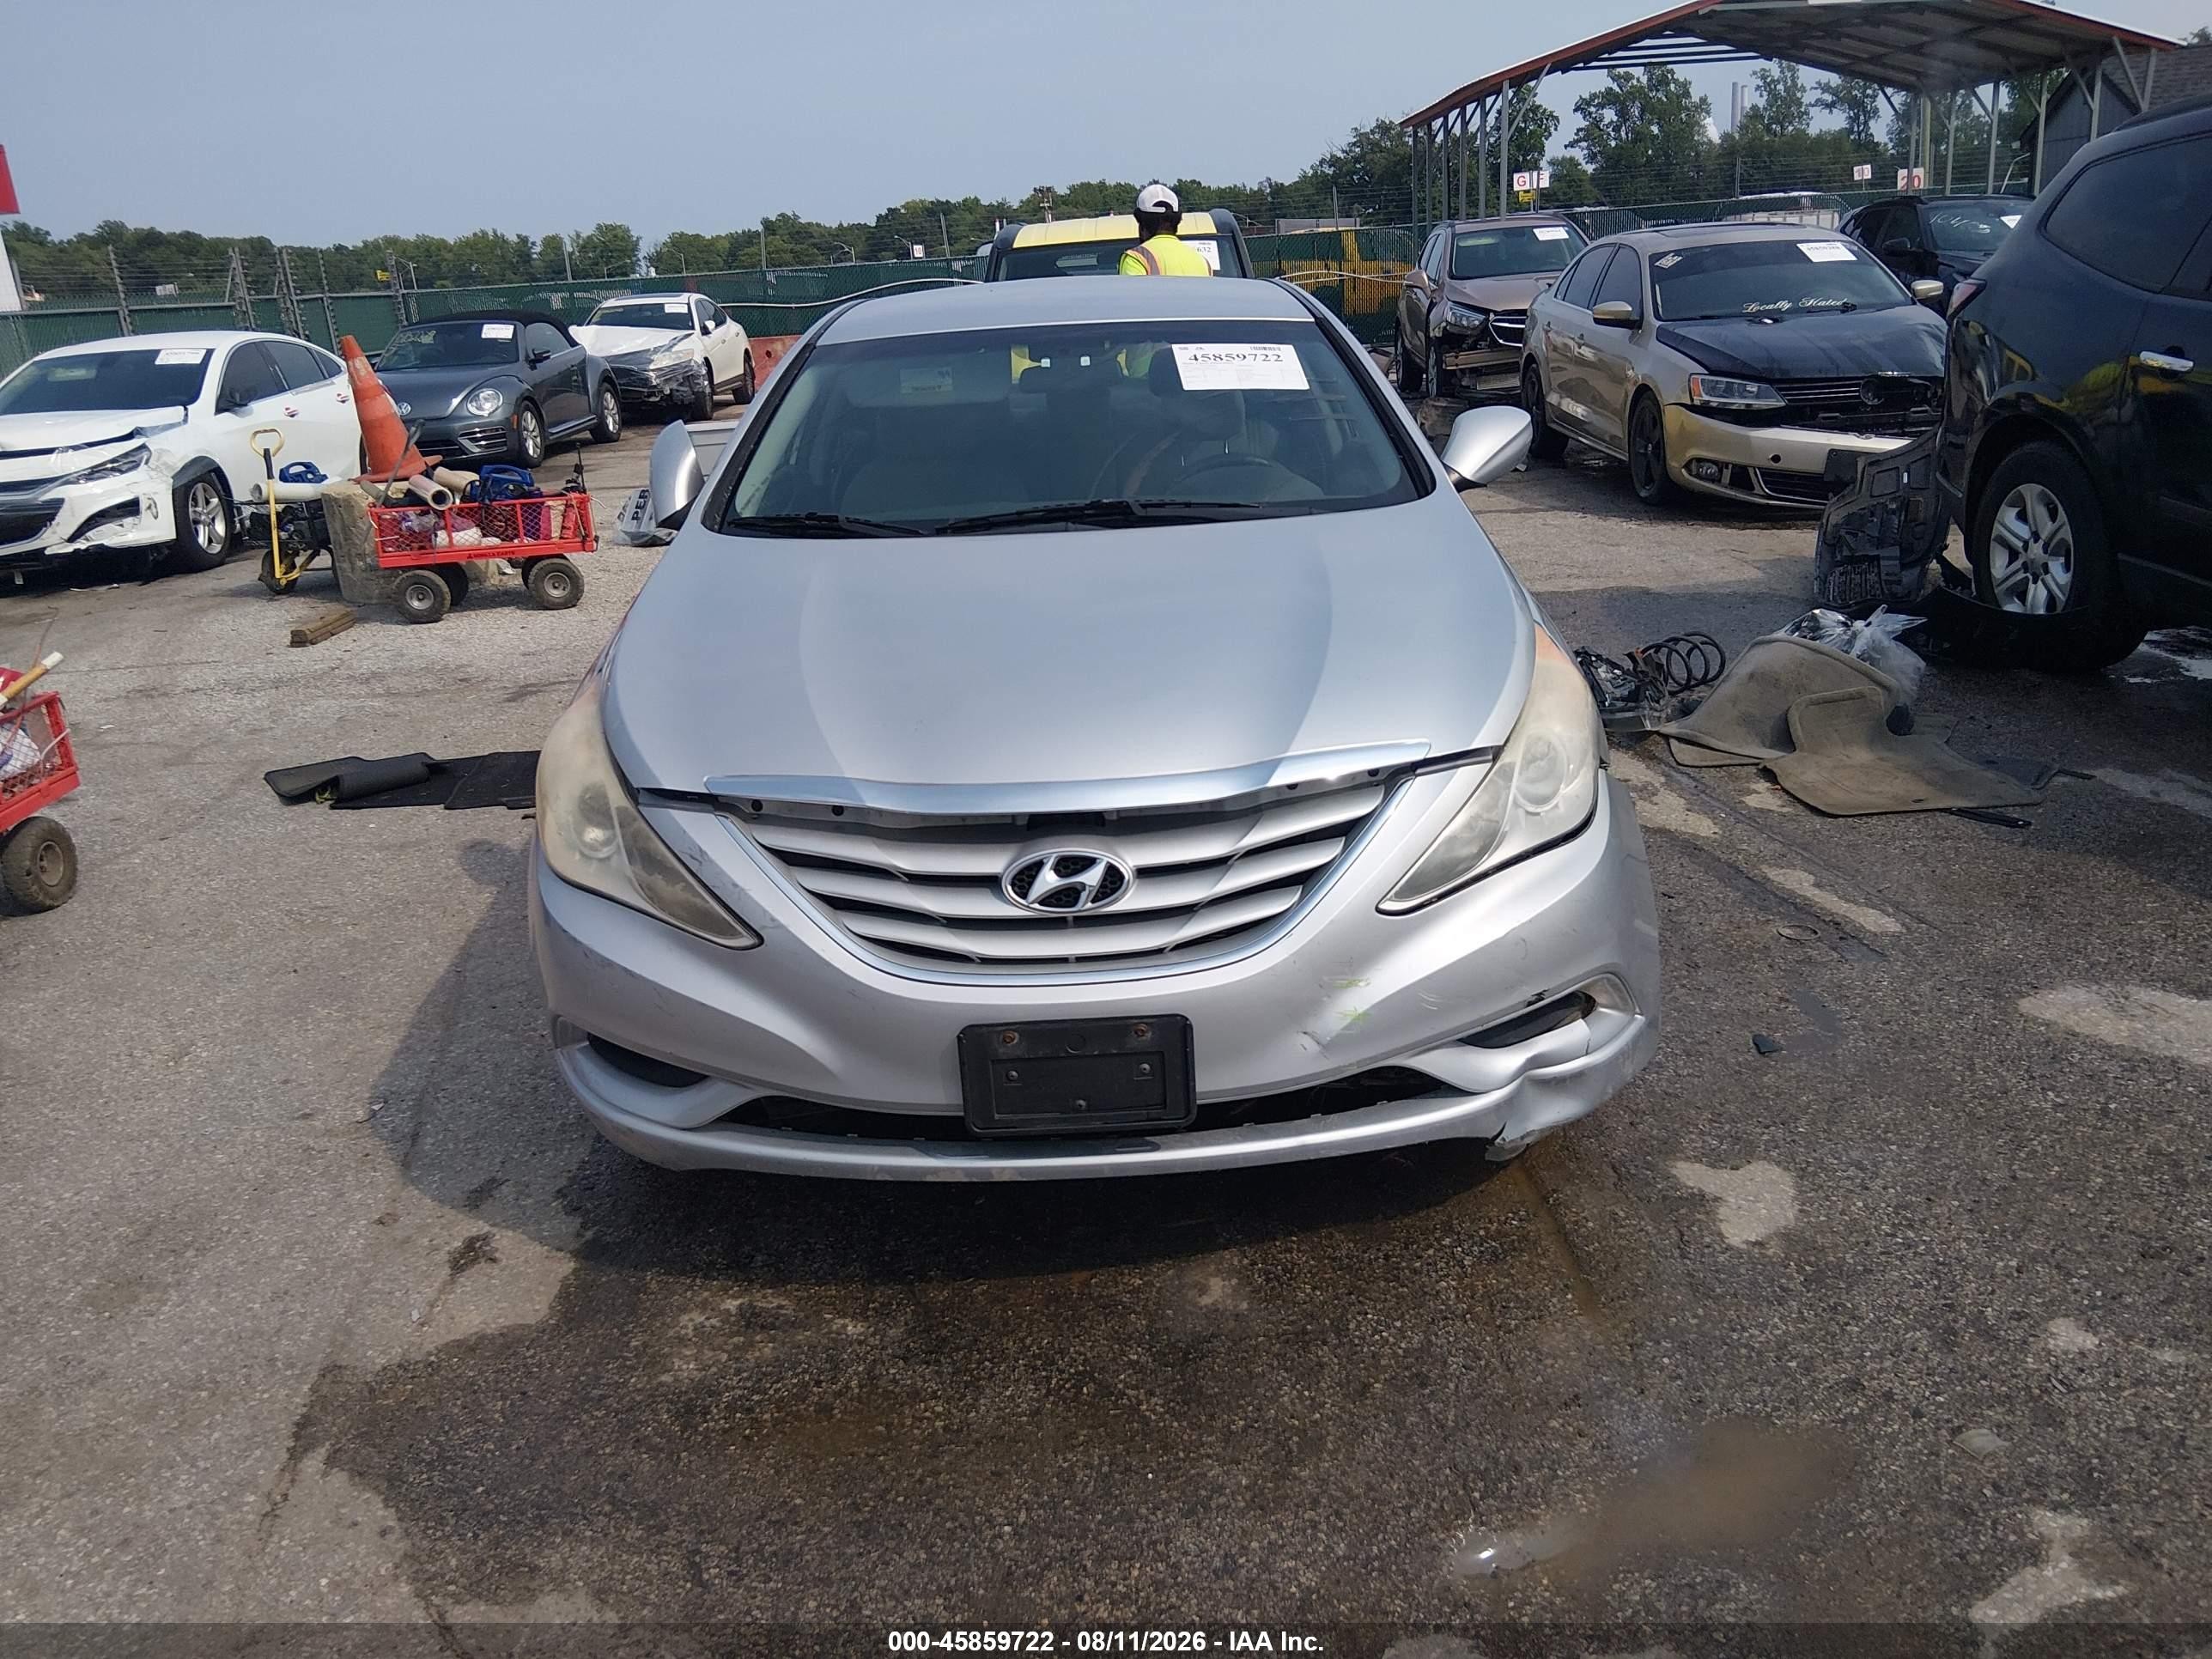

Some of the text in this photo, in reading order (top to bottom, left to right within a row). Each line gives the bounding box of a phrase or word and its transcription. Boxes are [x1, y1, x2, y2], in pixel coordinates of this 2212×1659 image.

[1516, 175, 1527, 186] G
[1742, 300, 1793, 313] Locally
[1188, 352, 1285, 362] 45859722
